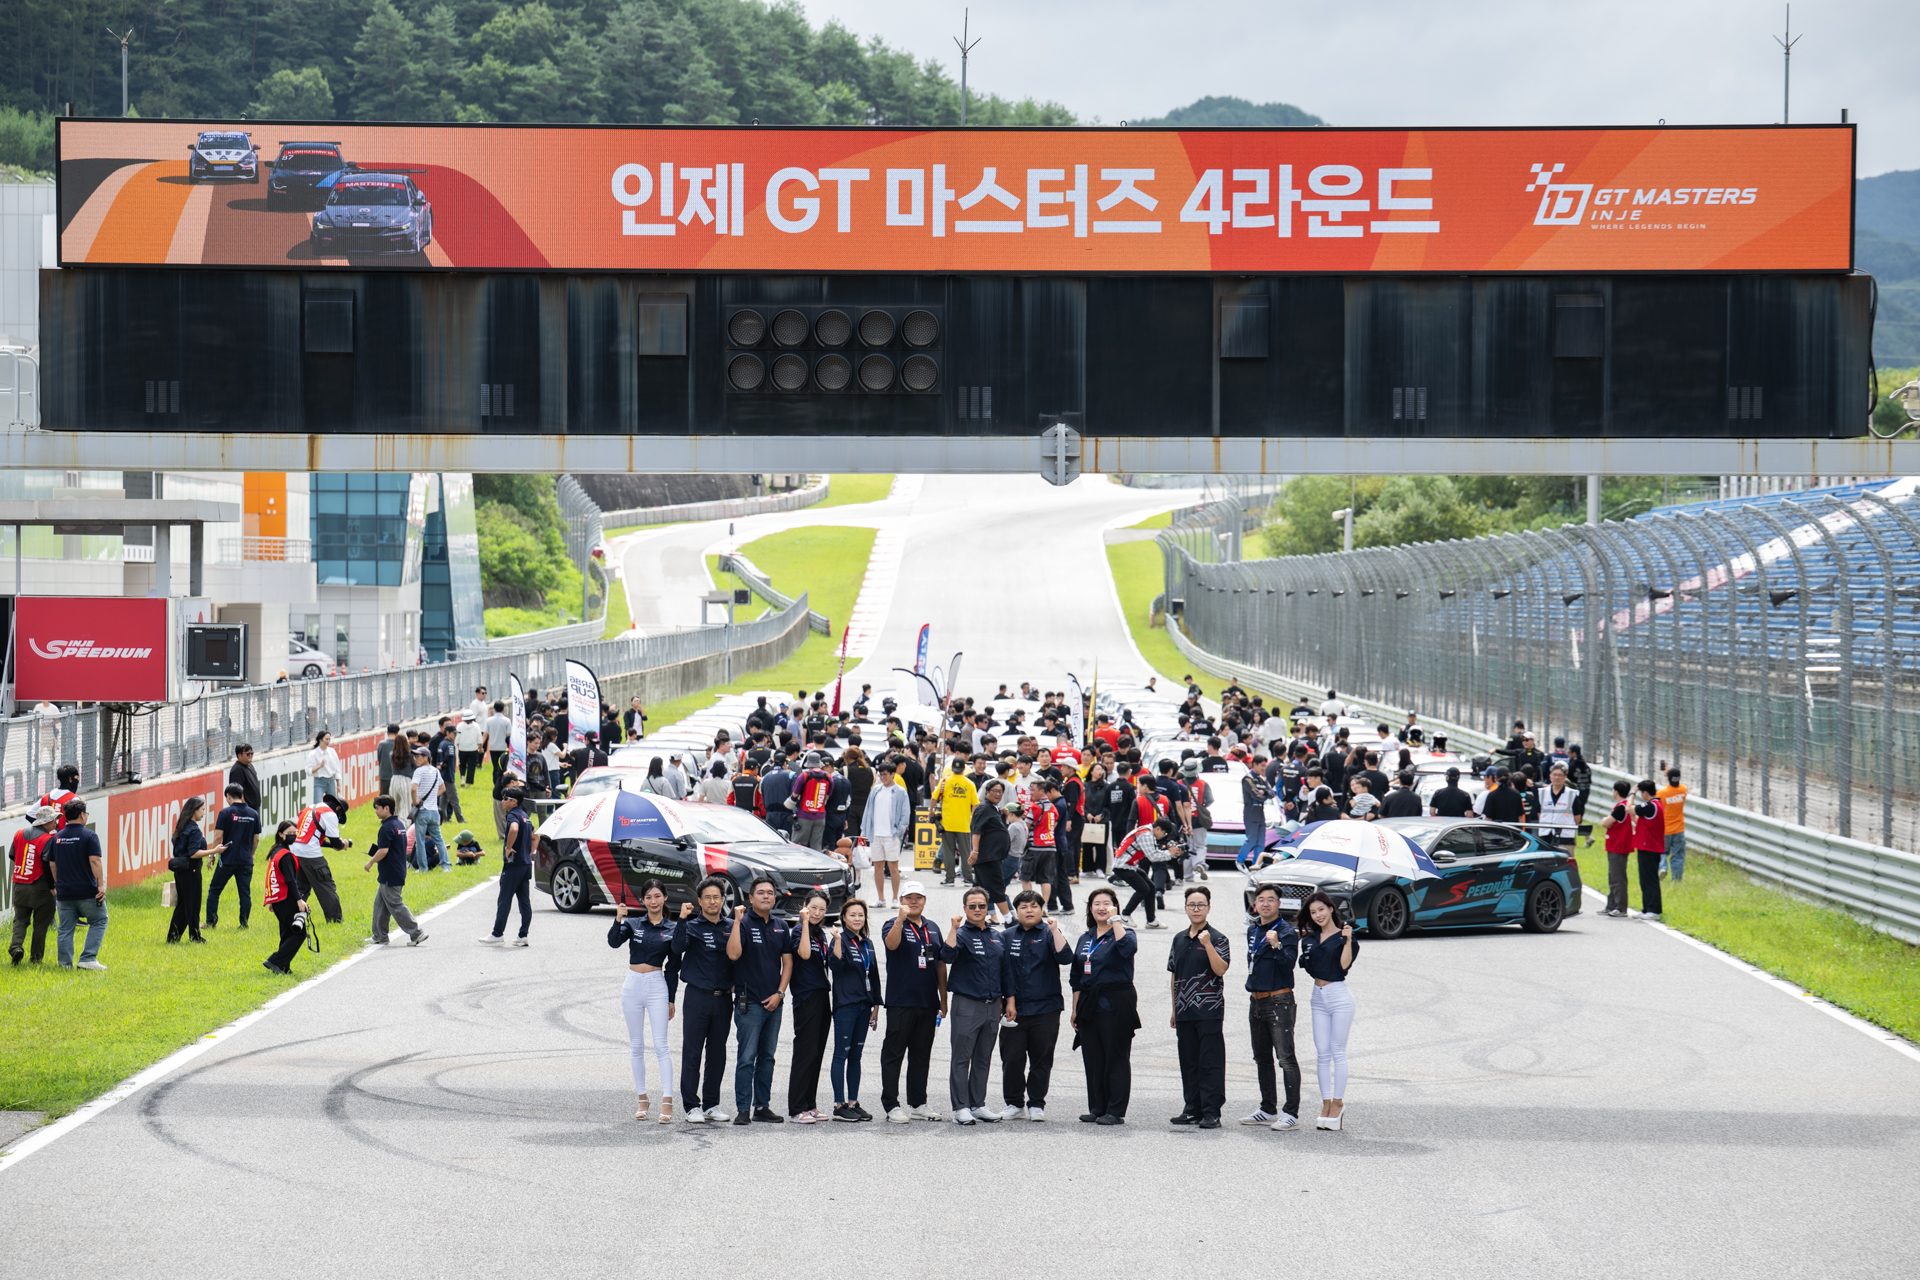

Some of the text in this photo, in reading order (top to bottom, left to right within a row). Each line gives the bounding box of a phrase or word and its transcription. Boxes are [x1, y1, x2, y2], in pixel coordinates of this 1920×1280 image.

[611, 162, 1441, 238] 인제 GT 마스터즈 4라운드
[1594, 187, 1759, 206] GT MASTERS
[1590, 210, 1643, 221] INJE
[29, 638, 153, 660] SPEEDIUM
[67, 639, 96, 648] INJE
[280, 769, 307, 821] TIRE
[805, 799, 815, 808] 05
[816, 782, 827, 809] MEDIA
[118, 799, 181, 874] KUMHO
[24, 843, 36, 876] MEDIA
[629, 856, 684, 879] SPEEDIUM
[1436, 879, 1515, 907] SPEEDIUM
